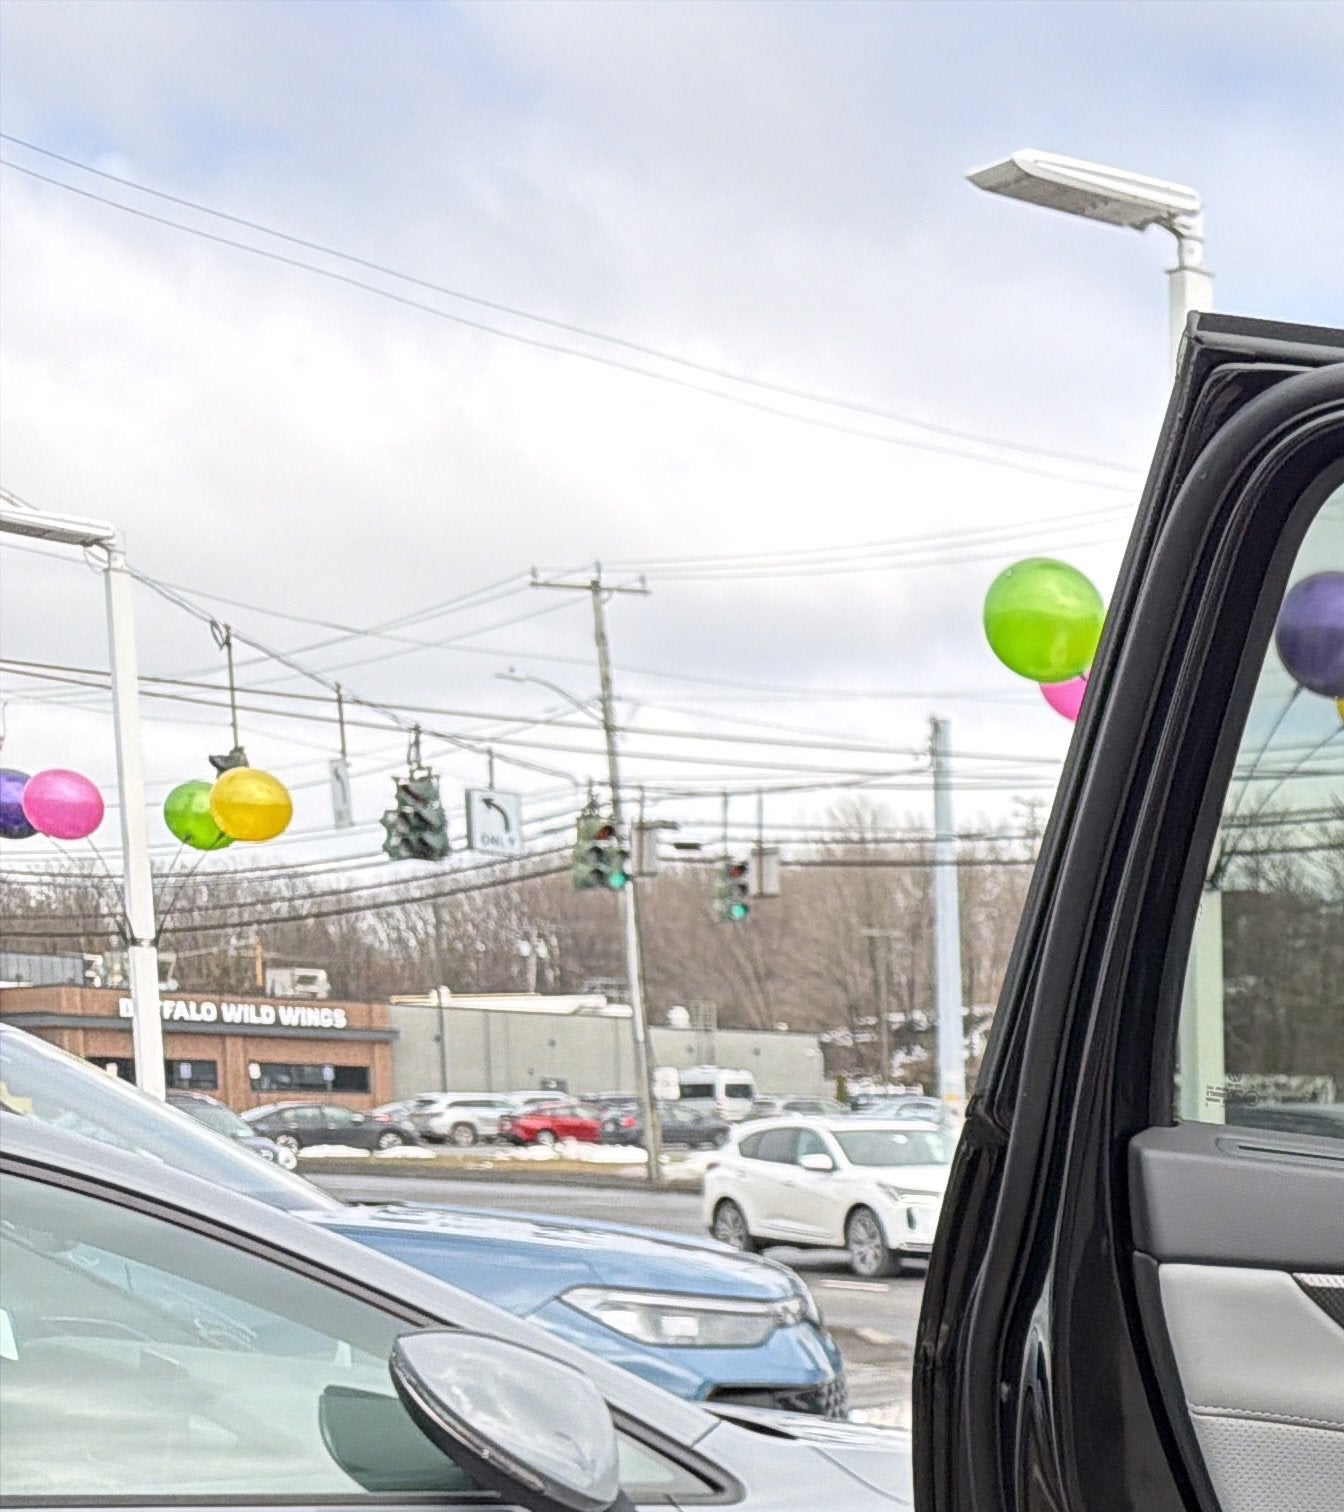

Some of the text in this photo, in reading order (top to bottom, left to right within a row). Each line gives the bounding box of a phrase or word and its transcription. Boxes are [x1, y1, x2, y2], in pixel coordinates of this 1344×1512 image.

[118, 998, 347, 1028] BFALO WILD WINGS
